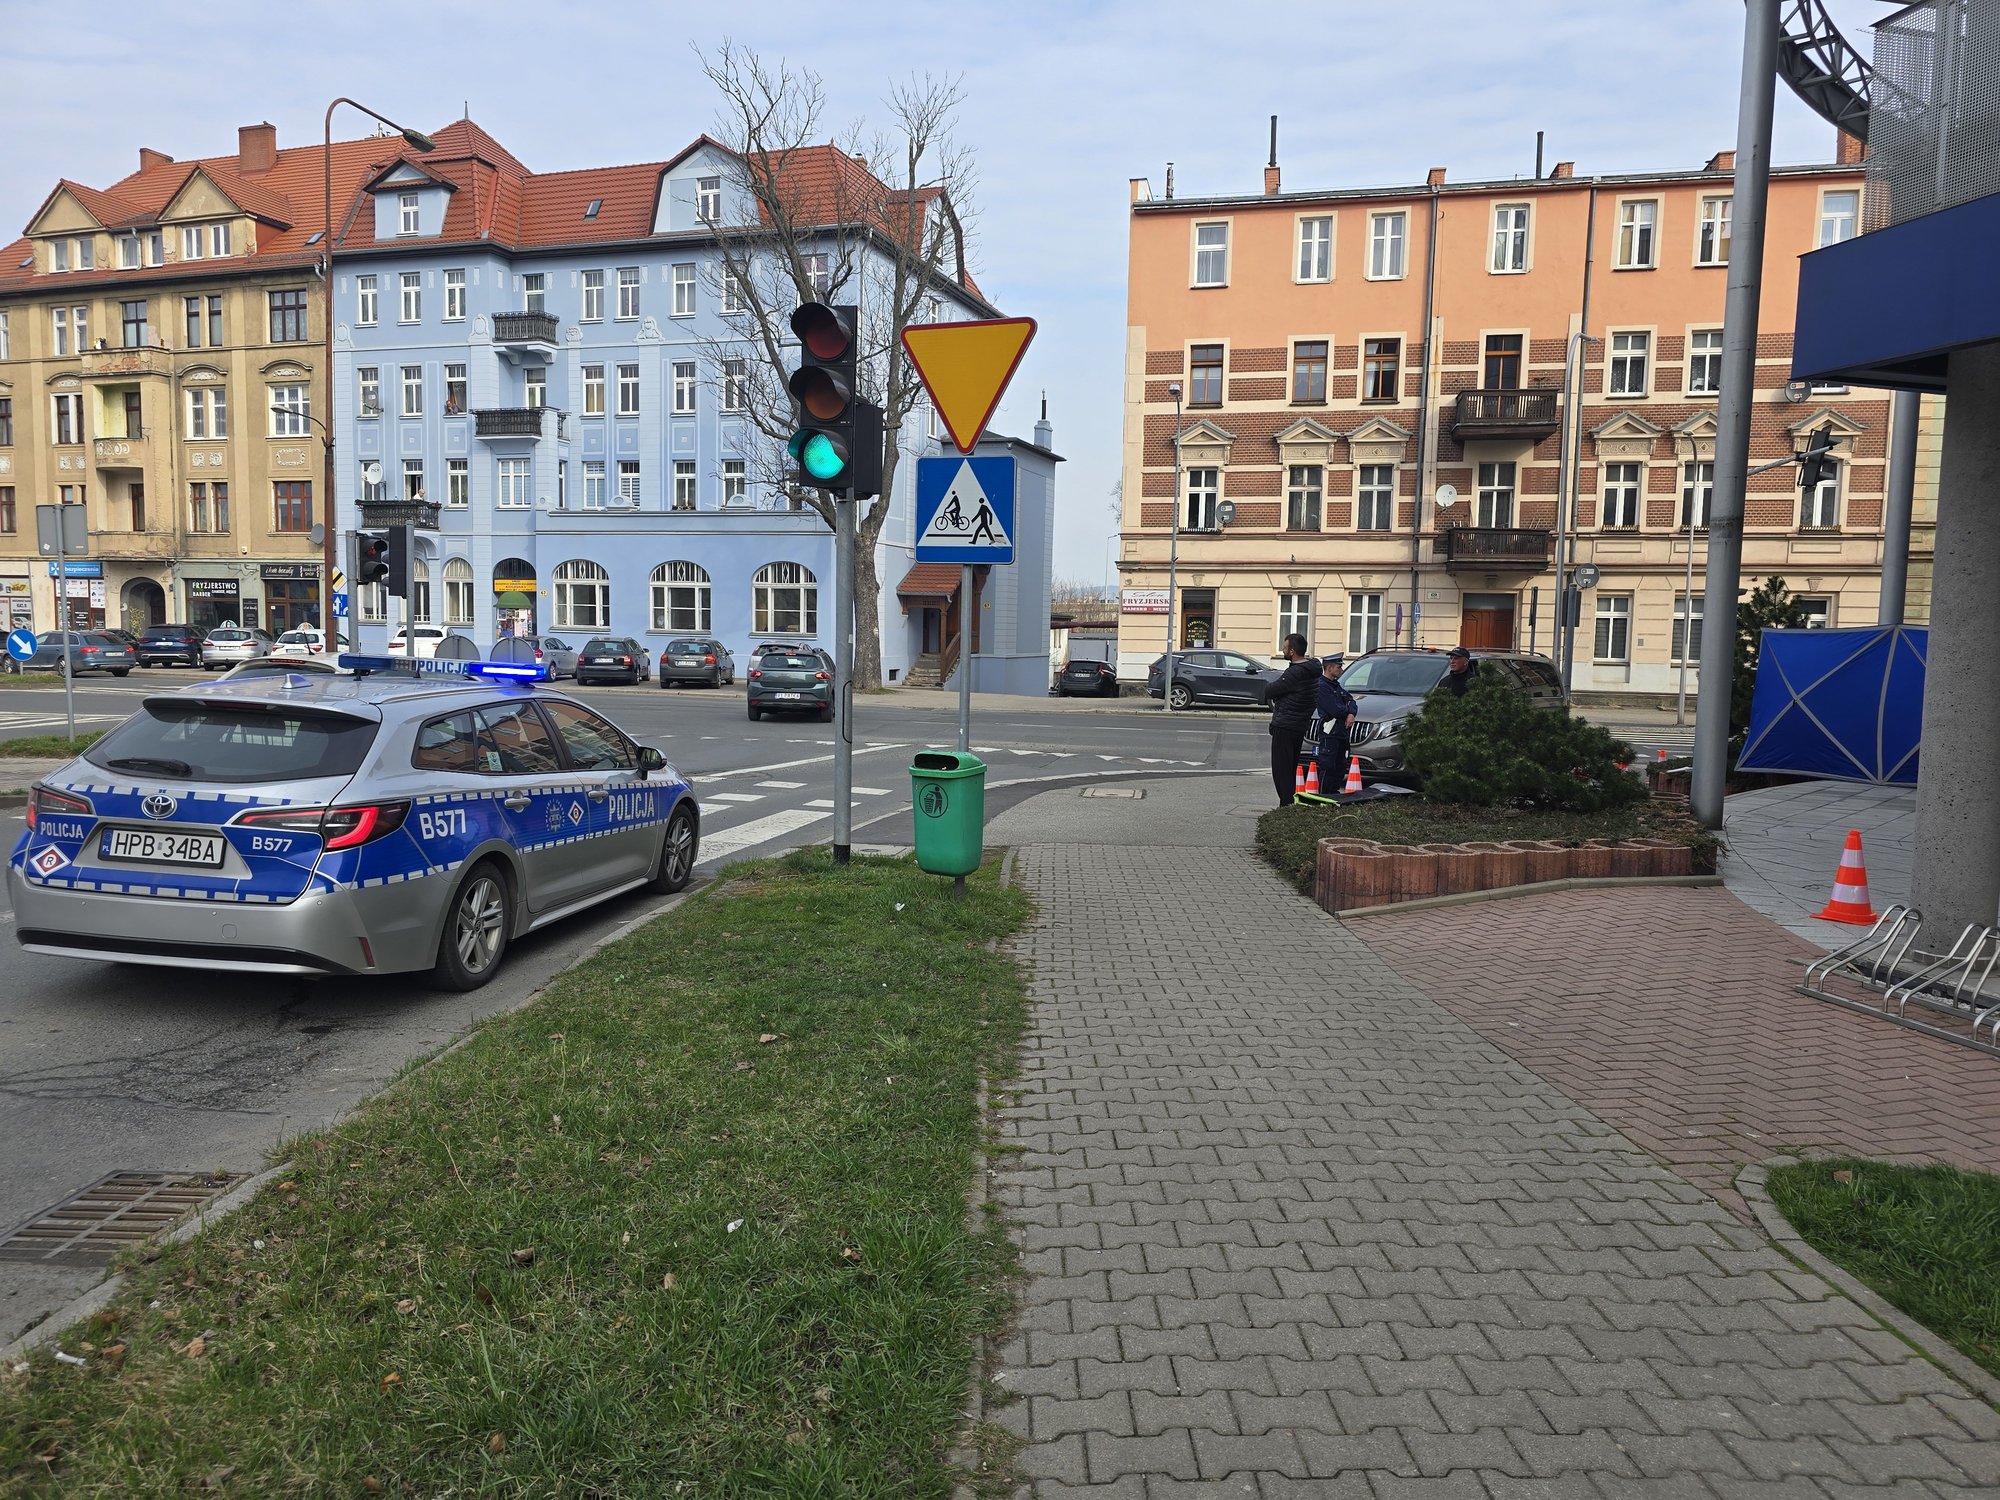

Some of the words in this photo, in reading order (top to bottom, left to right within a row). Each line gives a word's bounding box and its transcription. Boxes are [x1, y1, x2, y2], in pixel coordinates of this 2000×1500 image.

[192, 582, 237, 590] FRYZJERSTWO
[418, 660, 468, 675] POLICJA
[608, 792, 655, 823] POLICJA
[40, 821, 84, 839] POLICJA
[419, 808, 466, 840] B577
[114, 832, 155, 857] HPB
[162, 836, 215, 861] 34BA
[253, 837, 293, 853] B577
[45, 856, 54, 866] R
